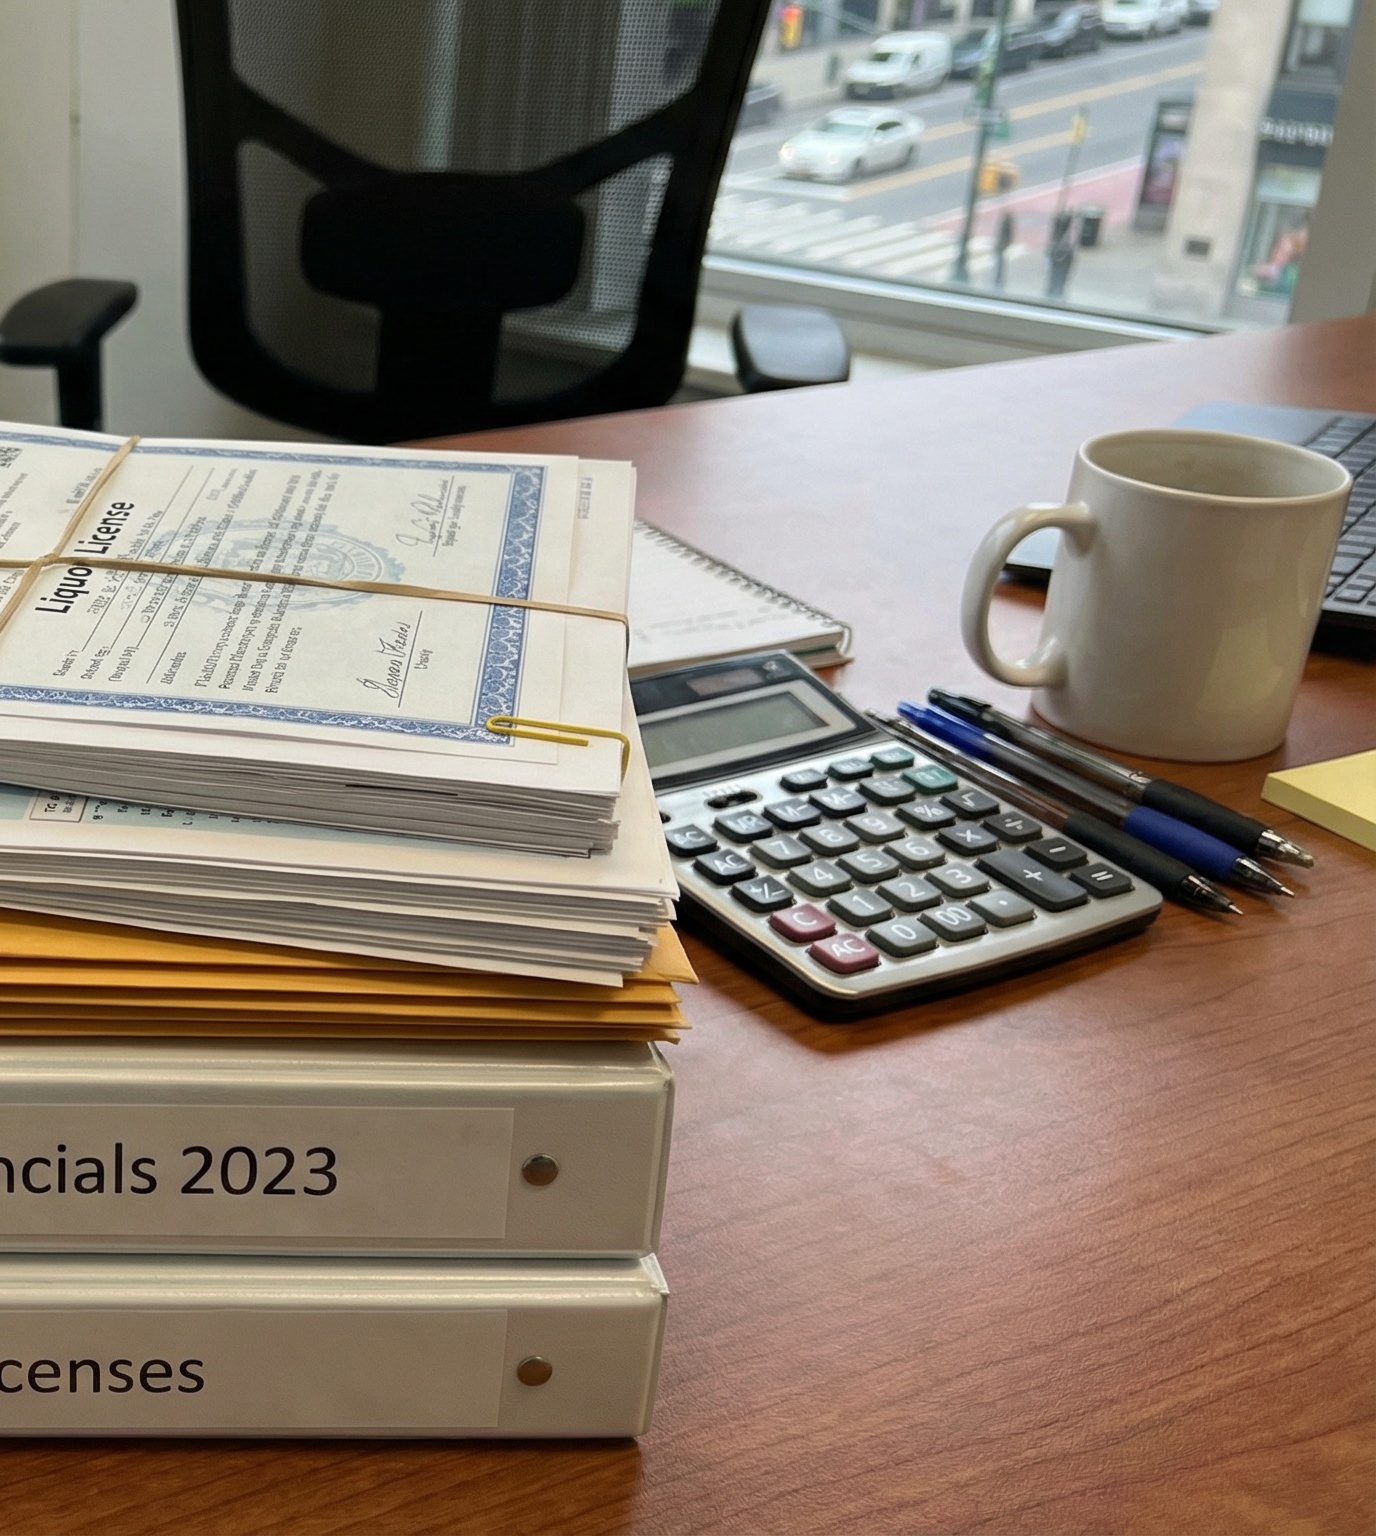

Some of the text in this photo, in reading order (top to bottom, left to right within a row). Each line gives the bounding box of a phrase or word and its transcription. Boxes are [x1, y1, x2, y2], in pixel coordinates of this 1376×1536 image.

[35, 561, 93, 614] Liquo
[74, 502, 134, 555] License
[769, 840, 790, 854] 7
[905, 841, 929, 856] 6
[713, 854, 747, 872] AC
[856, 854, 884, 868] 5
[813, 867, 833, 881] 4
[946, 869, 972, 884] 3
[898, 882, 926, 898] 2
[852, 895, 875, 910] 1
[792, 911, 817, 926] C
[935, 906, 972, 926] 00
[891, 924, 917, 940] 0
[831, 939, 865, 957] AC
[181, 1146, 337, 1197] 2023
